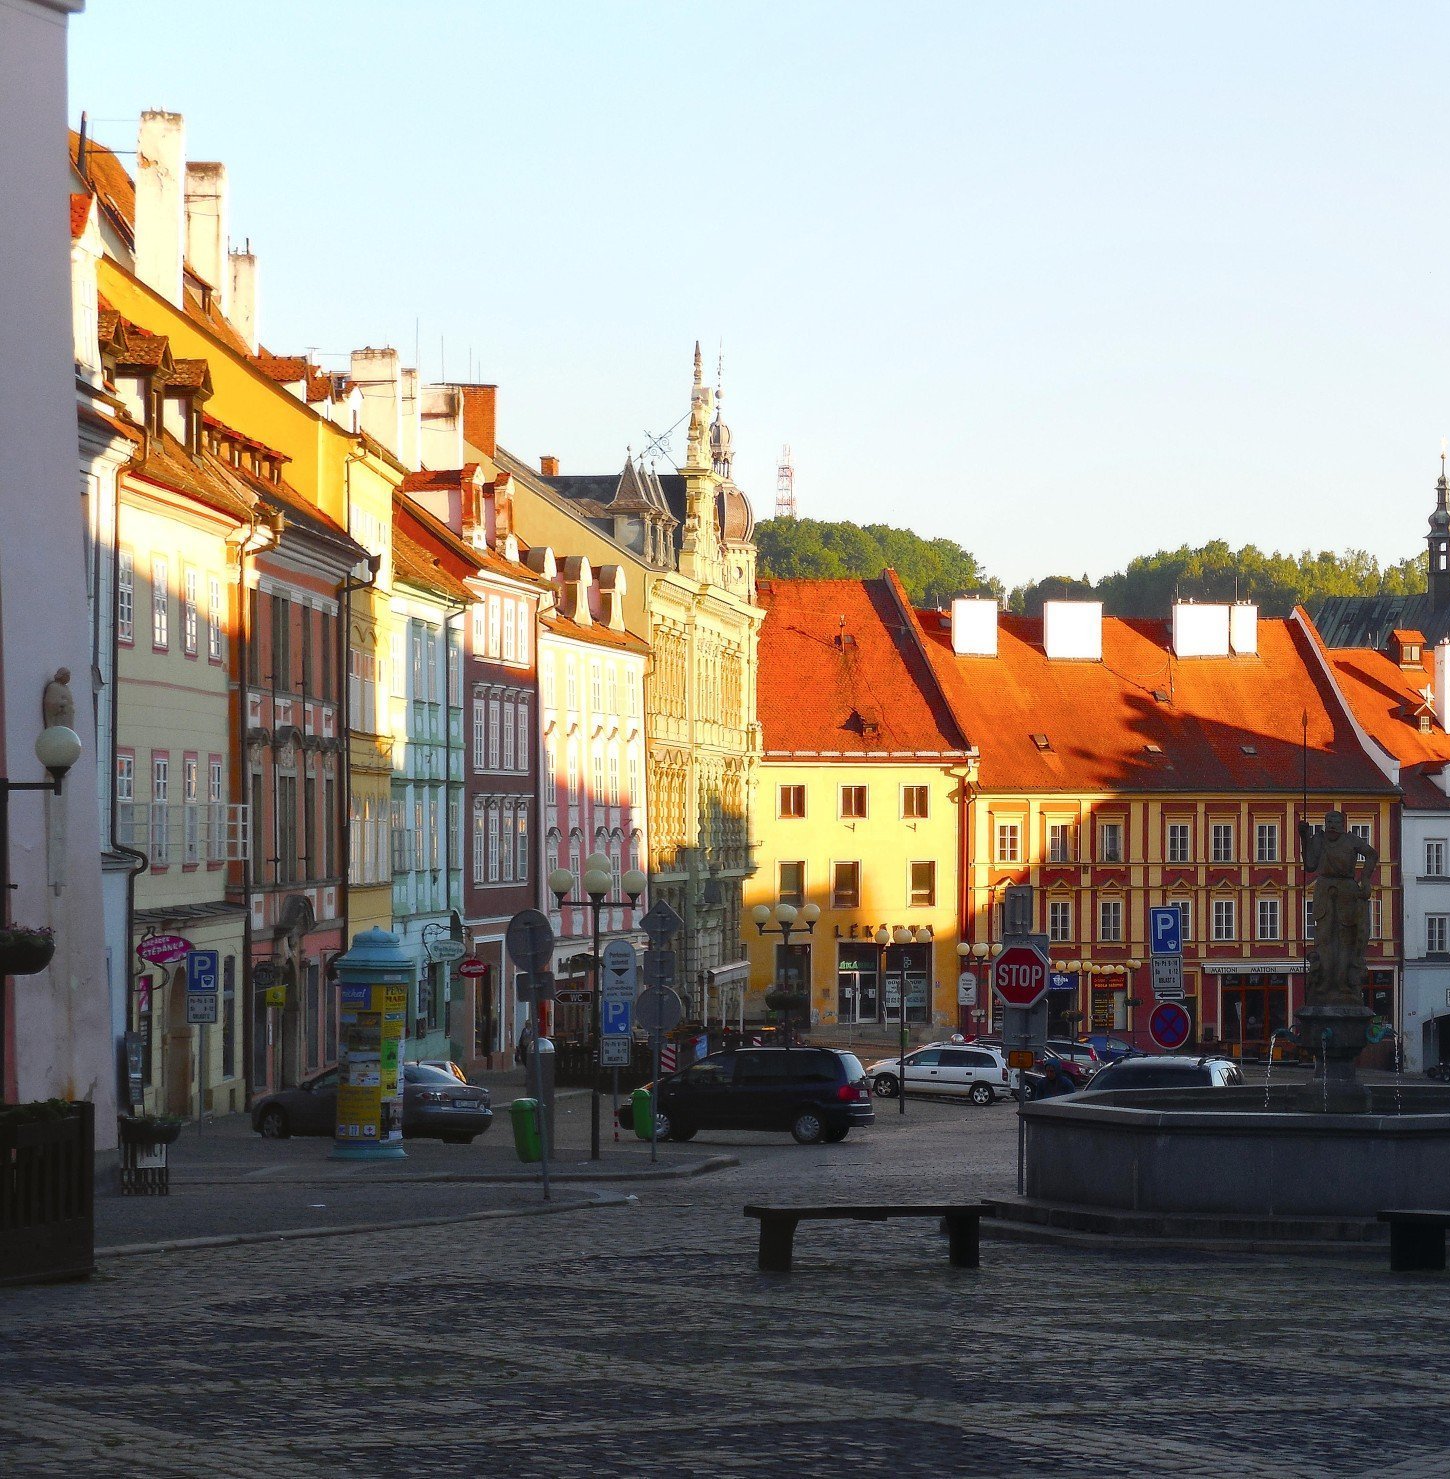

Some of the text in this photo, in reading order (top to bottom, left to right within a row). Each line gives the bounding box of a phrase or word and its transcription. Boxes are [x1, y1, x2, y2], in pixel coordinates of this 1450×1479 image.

[1157, 913, 1174, 940] P
[194, 955, 211, 979] P
[998, 964, 1043, 988] STOP
[571, 993, 583, 1002] WC
[608, 1002, 624, 1024] P
